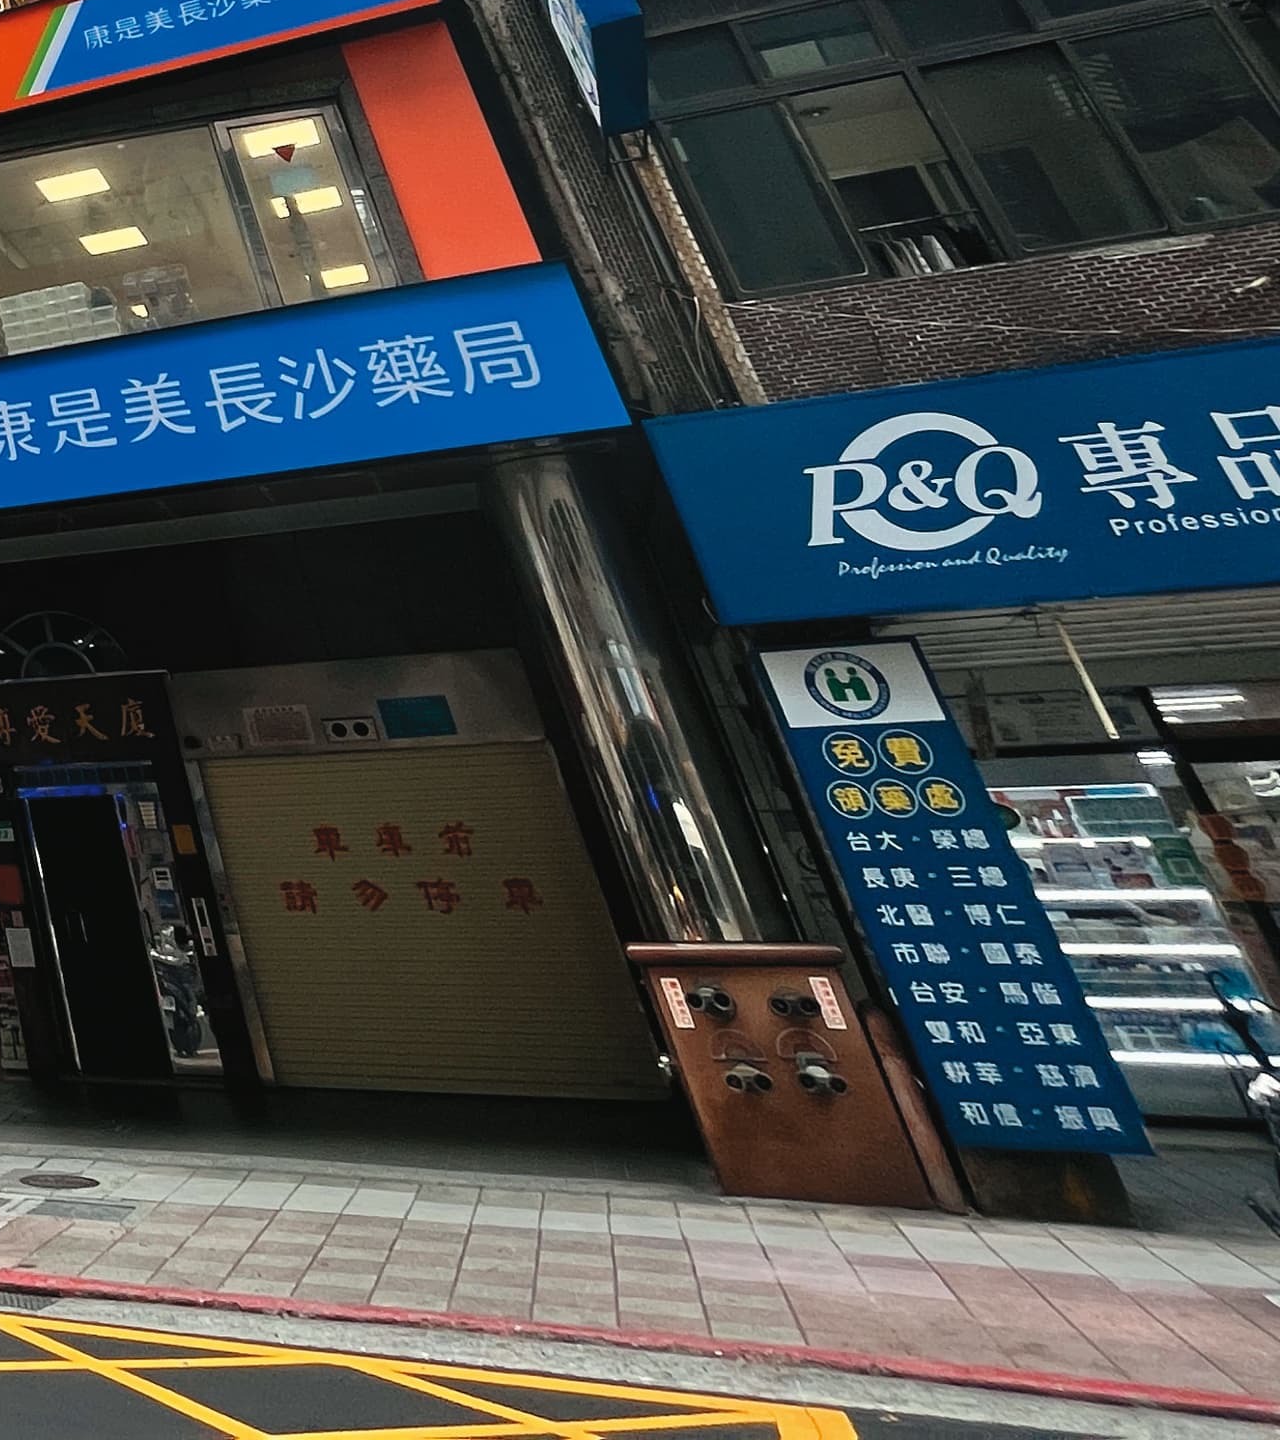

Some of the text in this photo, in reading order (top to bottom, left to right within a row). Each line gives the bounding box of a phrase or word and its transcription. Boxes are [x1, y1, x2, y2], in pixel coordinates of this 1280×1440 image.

[838, 545, 1069, 580] Profession and Quality
[830, 736, 928, 768] 免費
[832, 783, 960, 812] 領藥處
[846, 828, 991, 852] 台大 榮總
[862, 866, 1008, 889] 長庚 三總
[876, 903, 935, 927] 北醫
[891, 942, 1044, 966] 市聯 國泰
[910, 980, 1063, 1006] 台安 馬偕
[924, 1020, 1083, 1046] 雙和 亞東
[1034, 1063, 1101, 1089] 慈濟
[959, 1101, 1024, 1127] 和信
